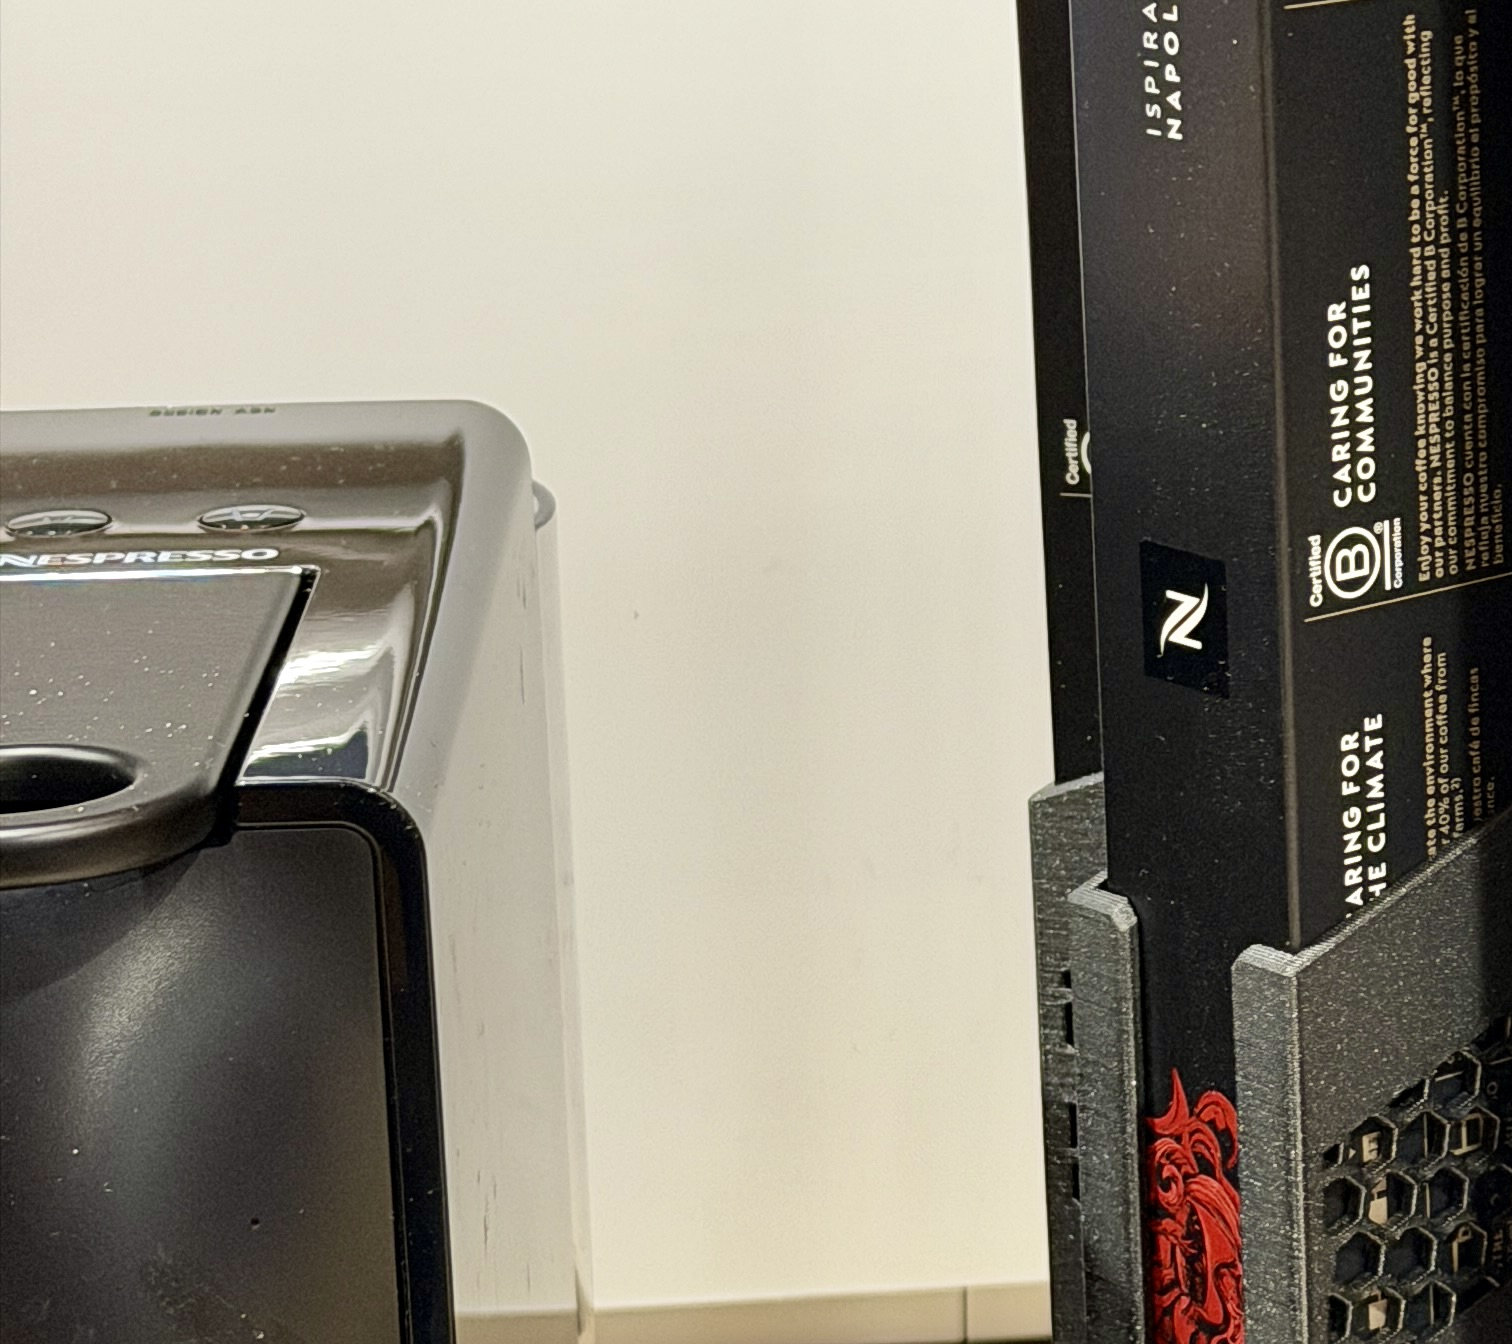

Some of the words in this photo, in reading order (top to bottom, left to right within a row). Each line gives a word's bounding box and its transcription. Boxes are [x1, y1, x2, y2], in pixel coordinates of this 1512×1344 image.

[1327, 302, 1348, 367] FOR
[1350, 265, 1376, 502] COMMUNITIES
[1063, 419, 1079, 484] Certified
[1330, 380, 1352, 507] CARING
[0, 548, 279, 567] NESPRESSO
[1308, 535, 1323, 607] Certified
[1335, 543, 1370, 582] B
[1392, 518, 1403, 588] Corporation
[1340, 732, 1360, 795] FOR
[1364, 714, 1386, 852] CLIMATE
[1343, 807, 1363, 918] ARING
[1368, 863, 1386, 901] HE
